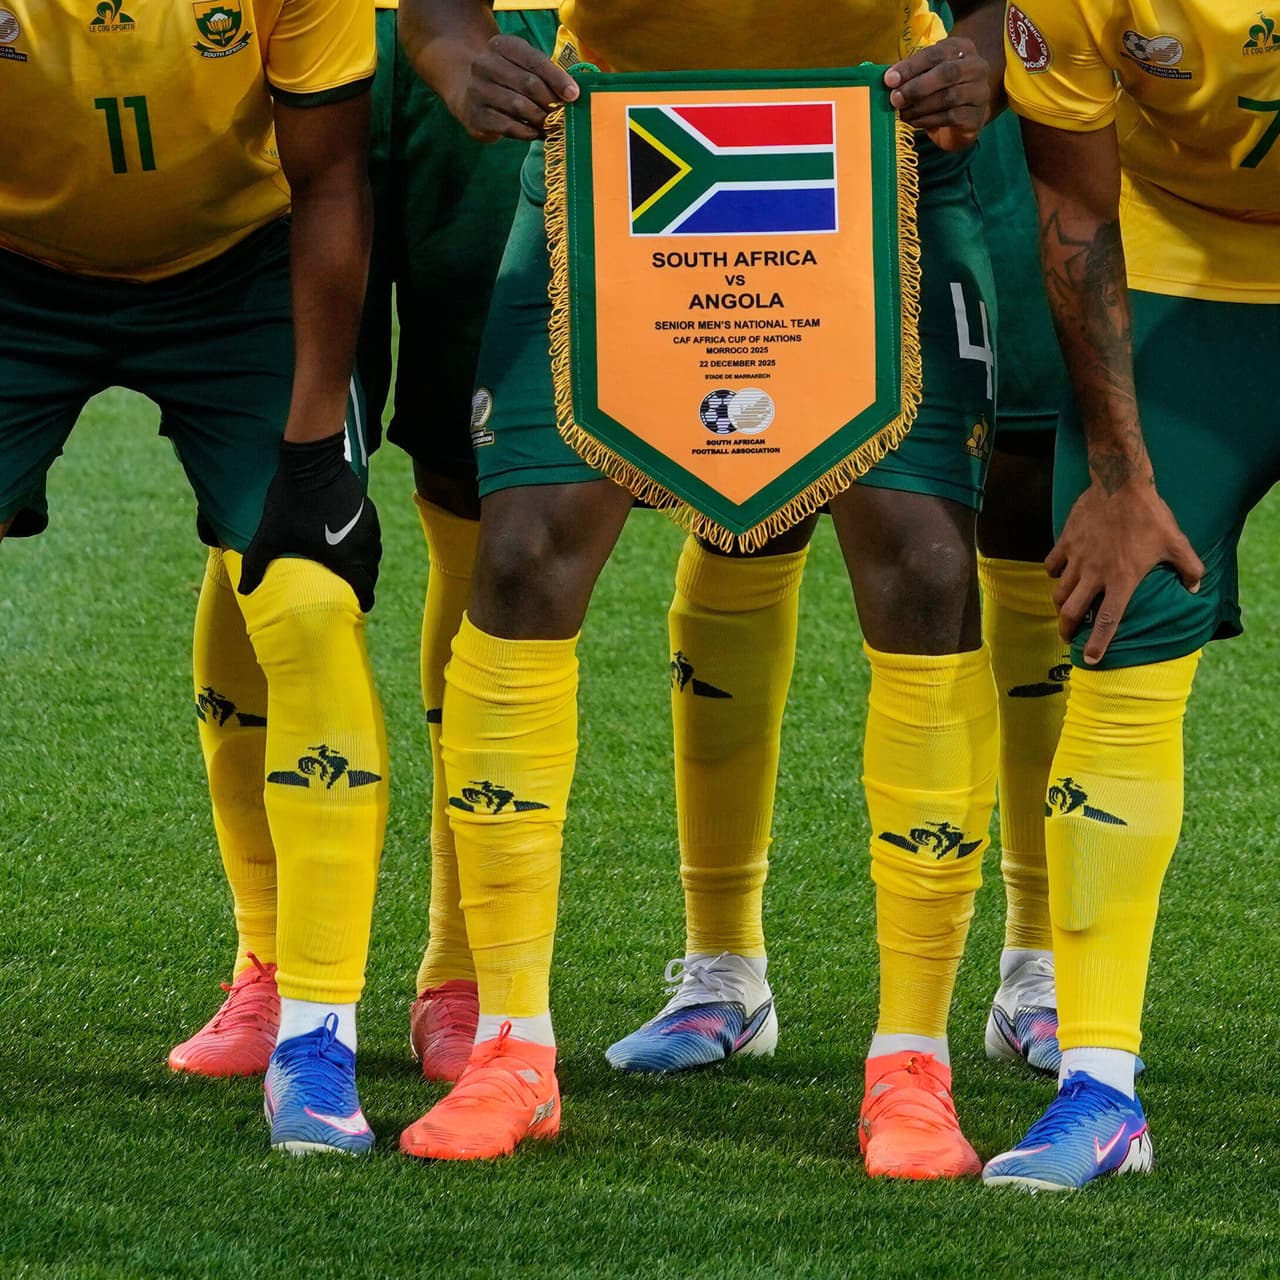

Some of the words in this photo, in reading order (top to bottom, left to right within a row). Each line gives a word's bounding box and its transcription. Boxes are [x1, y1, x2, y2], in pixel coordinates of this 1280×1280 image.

[203, 51, 224, 59] SOUTH
[224, 42, 248, 57] AFRICA
[96, 97, 153, 172] 11
[652, 251, 728, 268] SOUTH
[733, 249, 818, 267] AFRICA
[724, 274, 746, 287] VS
[688, 292, 785, 310] ANGOLA
[655, 321, 695, 330] SENIOR
[697, 320, 731, 330] MEN'S
[734, 320, 788, 329] NATIONAL
[790, 318, 821, 328] TEAM
[673, 336, 691, 345] CAF
[693, 335, 726, 344] AFRICA
[728, 335, 747, 344] CUP
[748, 335, 761, 344] OF
[763, 334, 802, 343] NATIONS
[950, 282, 994, 400] 4
[706, 347, 749, 355] MORROCO
[750, 346, 769, 354] 2025
[699, 360, 709, 368] 22
[710, 359, 756, 368] DECEMBER
[758, 359, 776, 367] 2025
[733, 438, 766, 446] AFRICAN
[731, 447, 781, 455] ASSOCIATION
